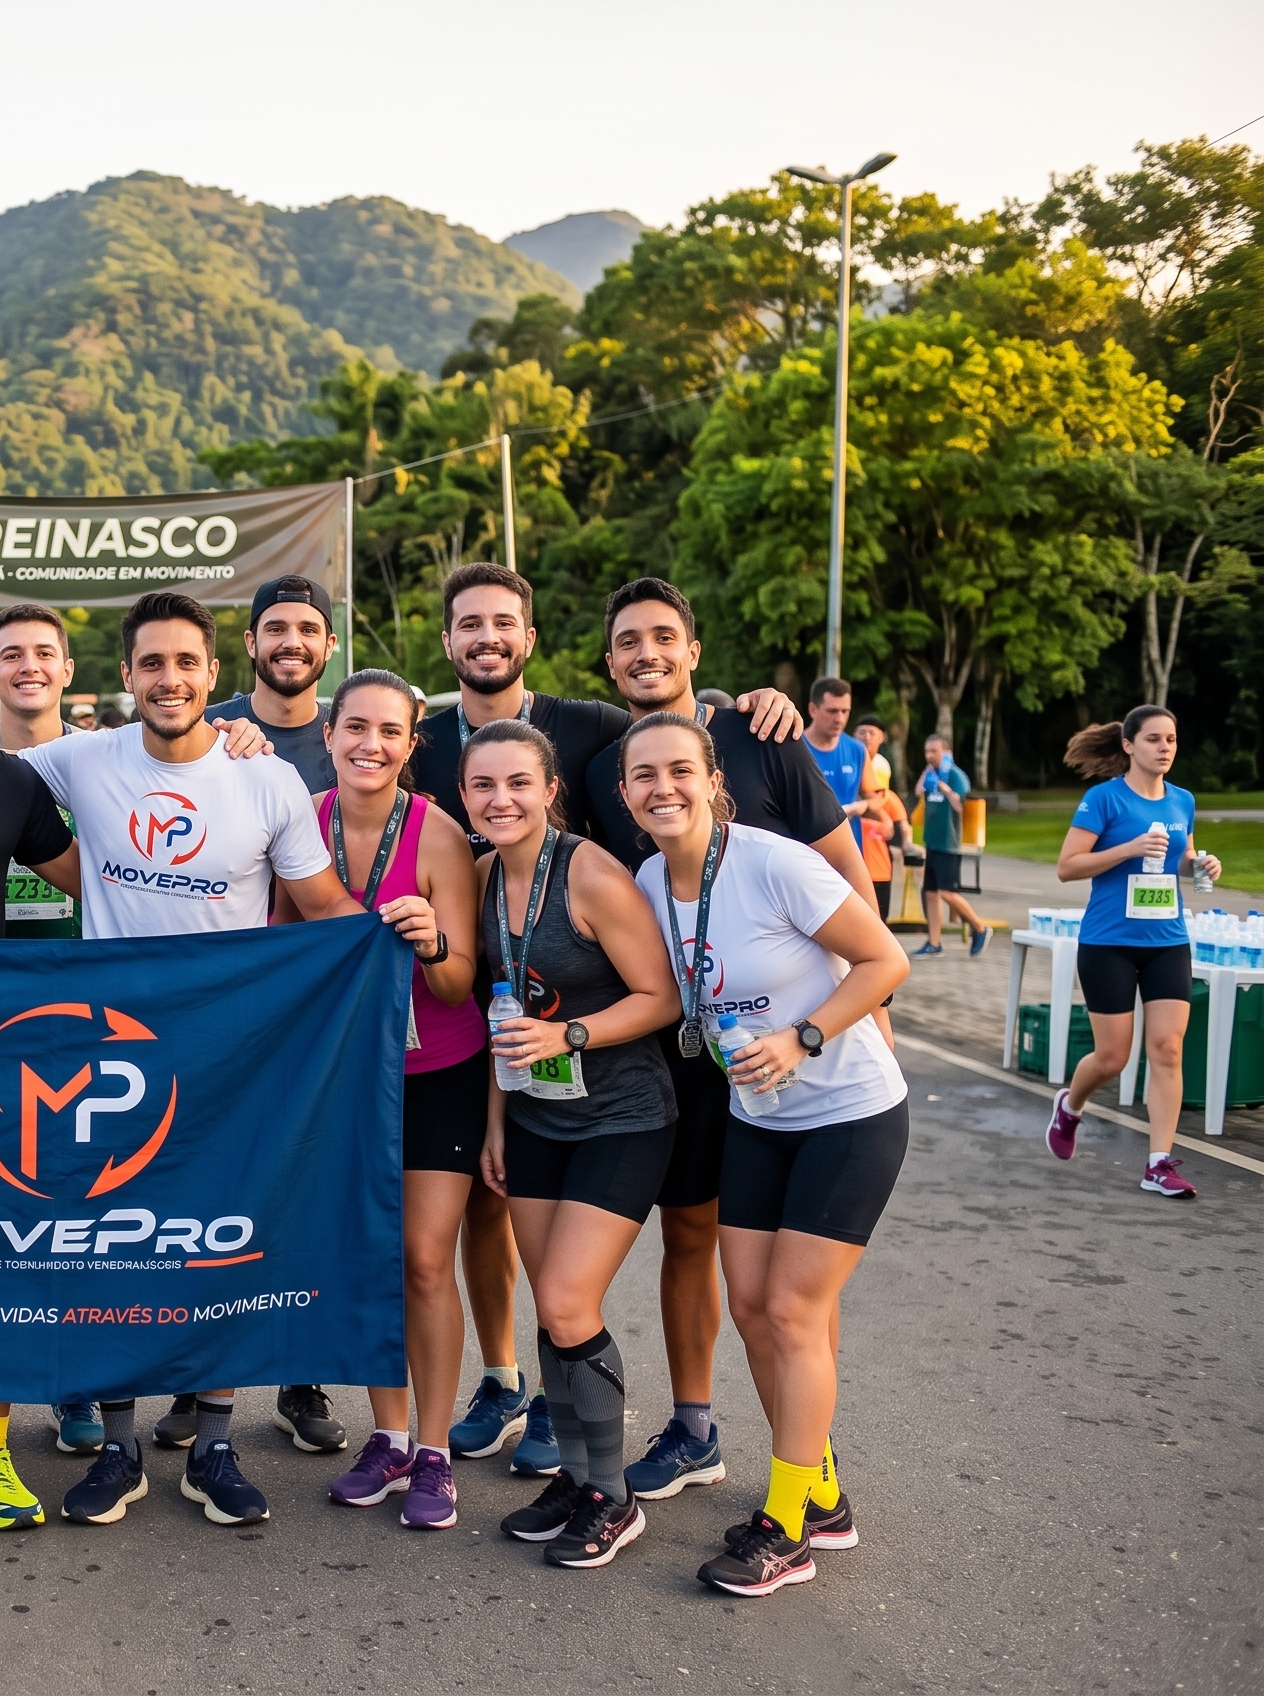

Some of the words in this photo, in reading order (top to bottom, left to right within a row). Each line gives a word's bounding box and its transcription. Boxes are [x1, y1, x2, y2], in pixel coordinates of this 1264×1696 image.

[15, 566, 118, 581] COMUNIDADE
[119, 566, 143, 580] EM
[144, 565, 236, 580] MOVIMENTO
[0, 1307, 59, 1324] VIDAS
[61, 1304, 153, 1324] ATRAVÉS
[157, 1308, 189, 1324] DO
[193, 1289, 319, 1322] MOVIMENTO"
